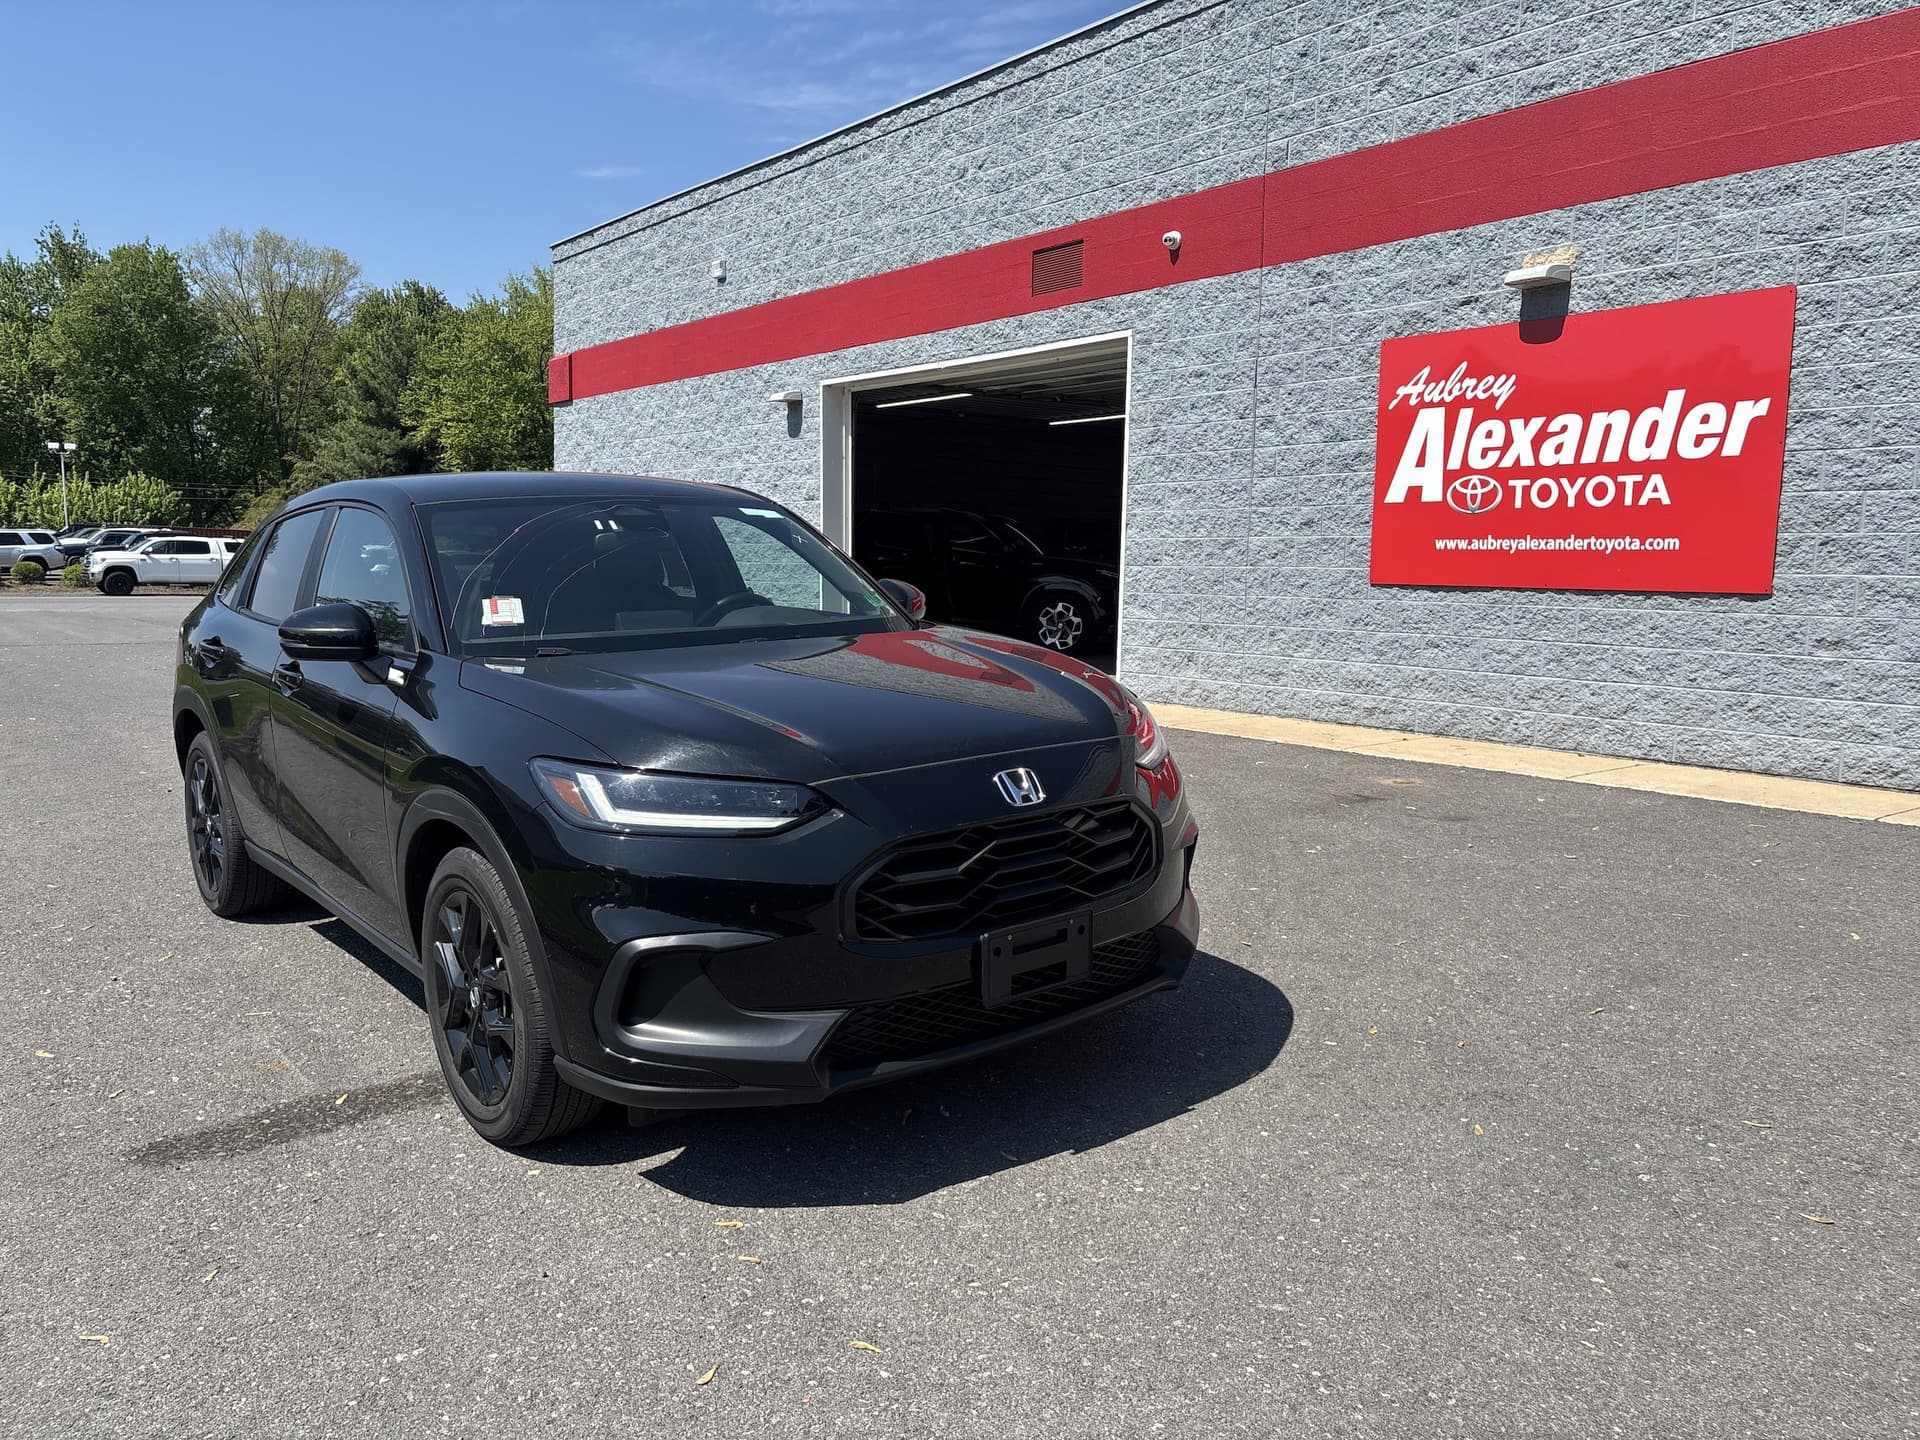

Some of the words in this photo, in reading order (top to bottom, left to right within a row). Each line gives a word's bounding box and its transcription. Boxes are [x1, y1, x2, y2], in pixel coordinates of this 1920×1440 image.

[1388, 361, 1516, 410] Aubrey
[1384, 388, 1771, 504] Alexander
[1508, 473, 1672, 509] TOYOTA
[1435, 535, 1680, 554] www.aubreyalexandertoyota.com
